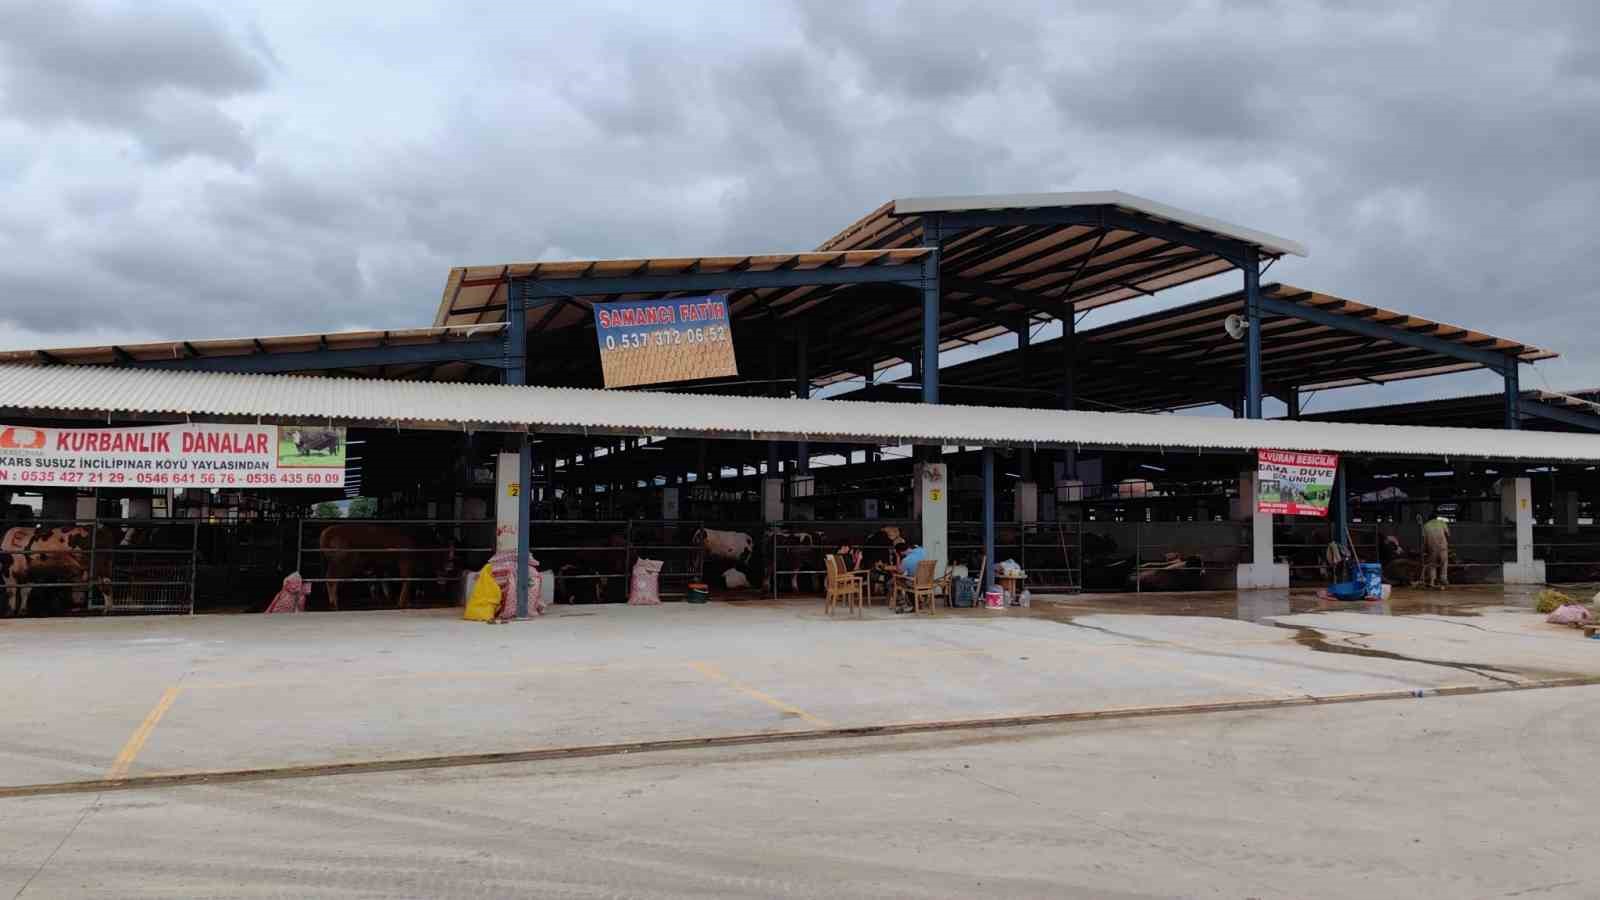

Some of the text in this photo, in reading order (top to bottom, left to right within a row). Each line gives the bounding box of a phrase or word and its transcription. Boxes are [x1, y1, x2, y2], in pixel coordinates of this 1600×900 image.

[599, 298, 724, 328] SAMANCI FATİH
[622, 333, 648, 348] 537
[656, 330, 681, 346] 372
[687, 329, 703, 343] 06
[56, 432, 268, 453] KURBANLIK DANALAR
[0, 457, 31, 467] KARS
[36, 458, 75, 468] SUSUZ
[80, 457, 151, 469] İNCİLİPINAR
[192, 460, 269, 470] YAYLASINDAN
[21, 471, 54, 481] 0535
[60, 472, 83, 482] 427
[88, 472, 103, 482] 21
[109, 472, 124, 482] 29
[137, 473, 168, 483] 0546
[173, 473, 194, 483] 641
[200, 474, 218, 483] 56
[222, 474, 235, 483] 76
[246, 473, 277, 483] 0536
[281, 473, 303, 483] 435
[306, 474, 321, 483] 60
[325, 473, 339, 483] 09
